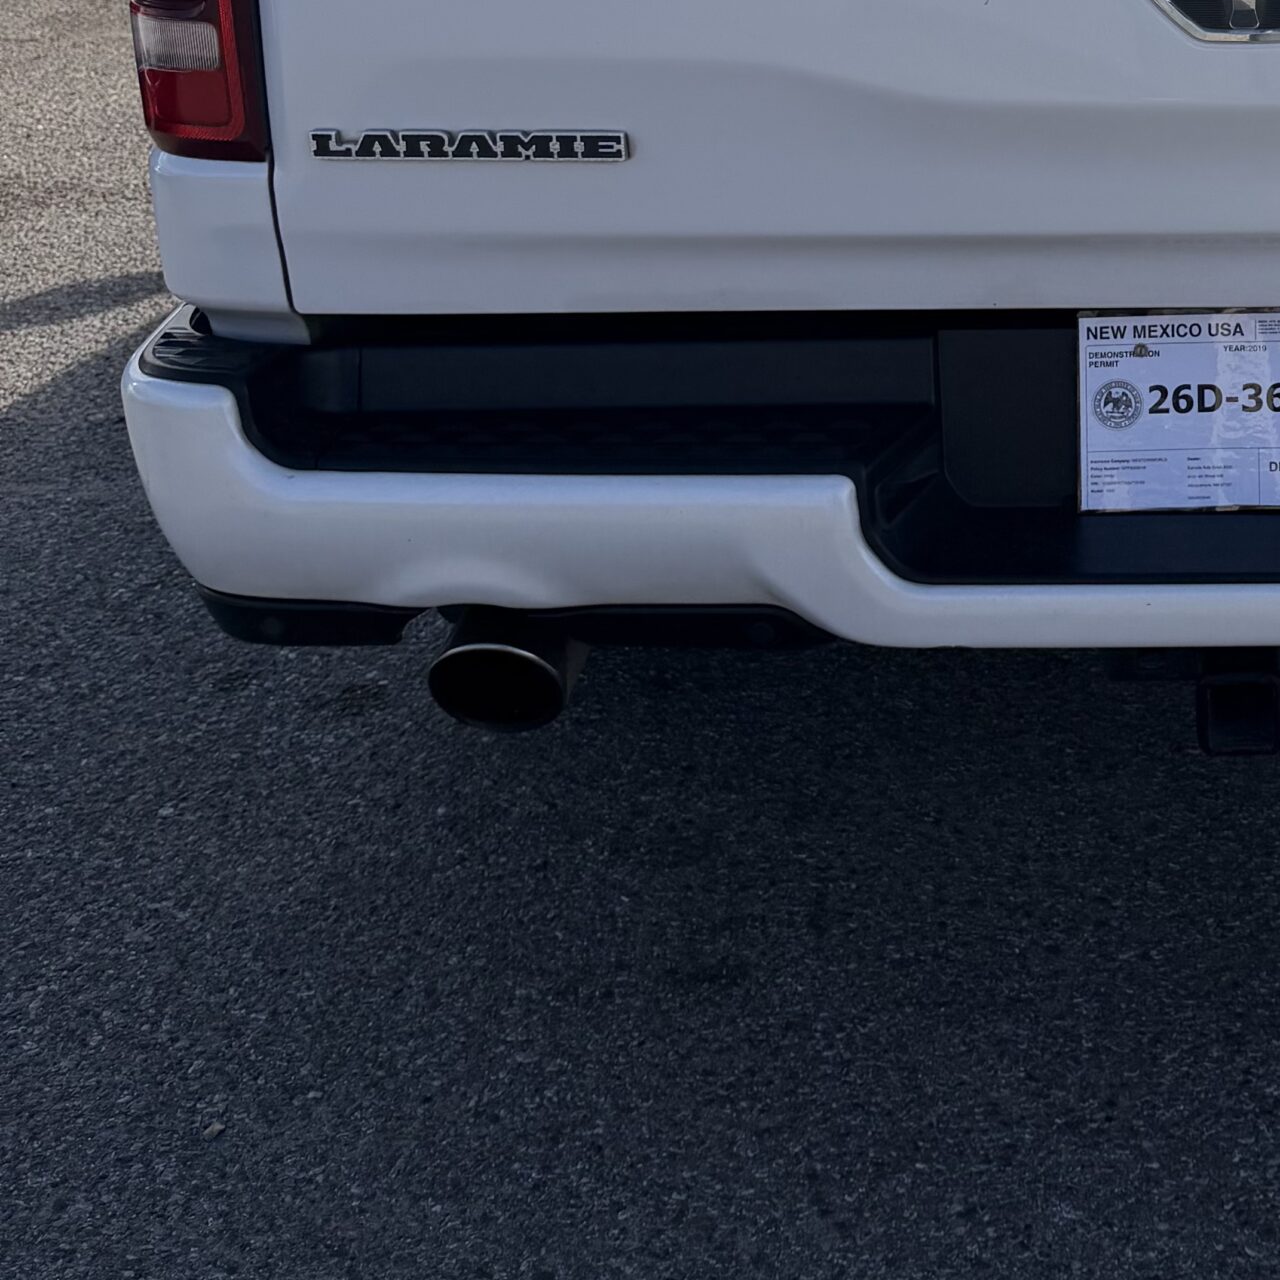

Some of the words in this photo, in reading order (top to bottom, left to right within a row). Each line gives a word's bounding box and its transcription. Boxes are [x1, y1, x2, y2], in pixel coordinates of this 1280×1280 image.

[309, 129, 627, 162] LARAMIE
[1086, 325, 1127, 340] NEW
[1132, 323, 1202, 339] MEXICO
[1208, 322, 1245, 337] USA
[1088, 350, 1160, 359] DEMONSTRON
[1088, 360, 1120, 368] PERMIT
